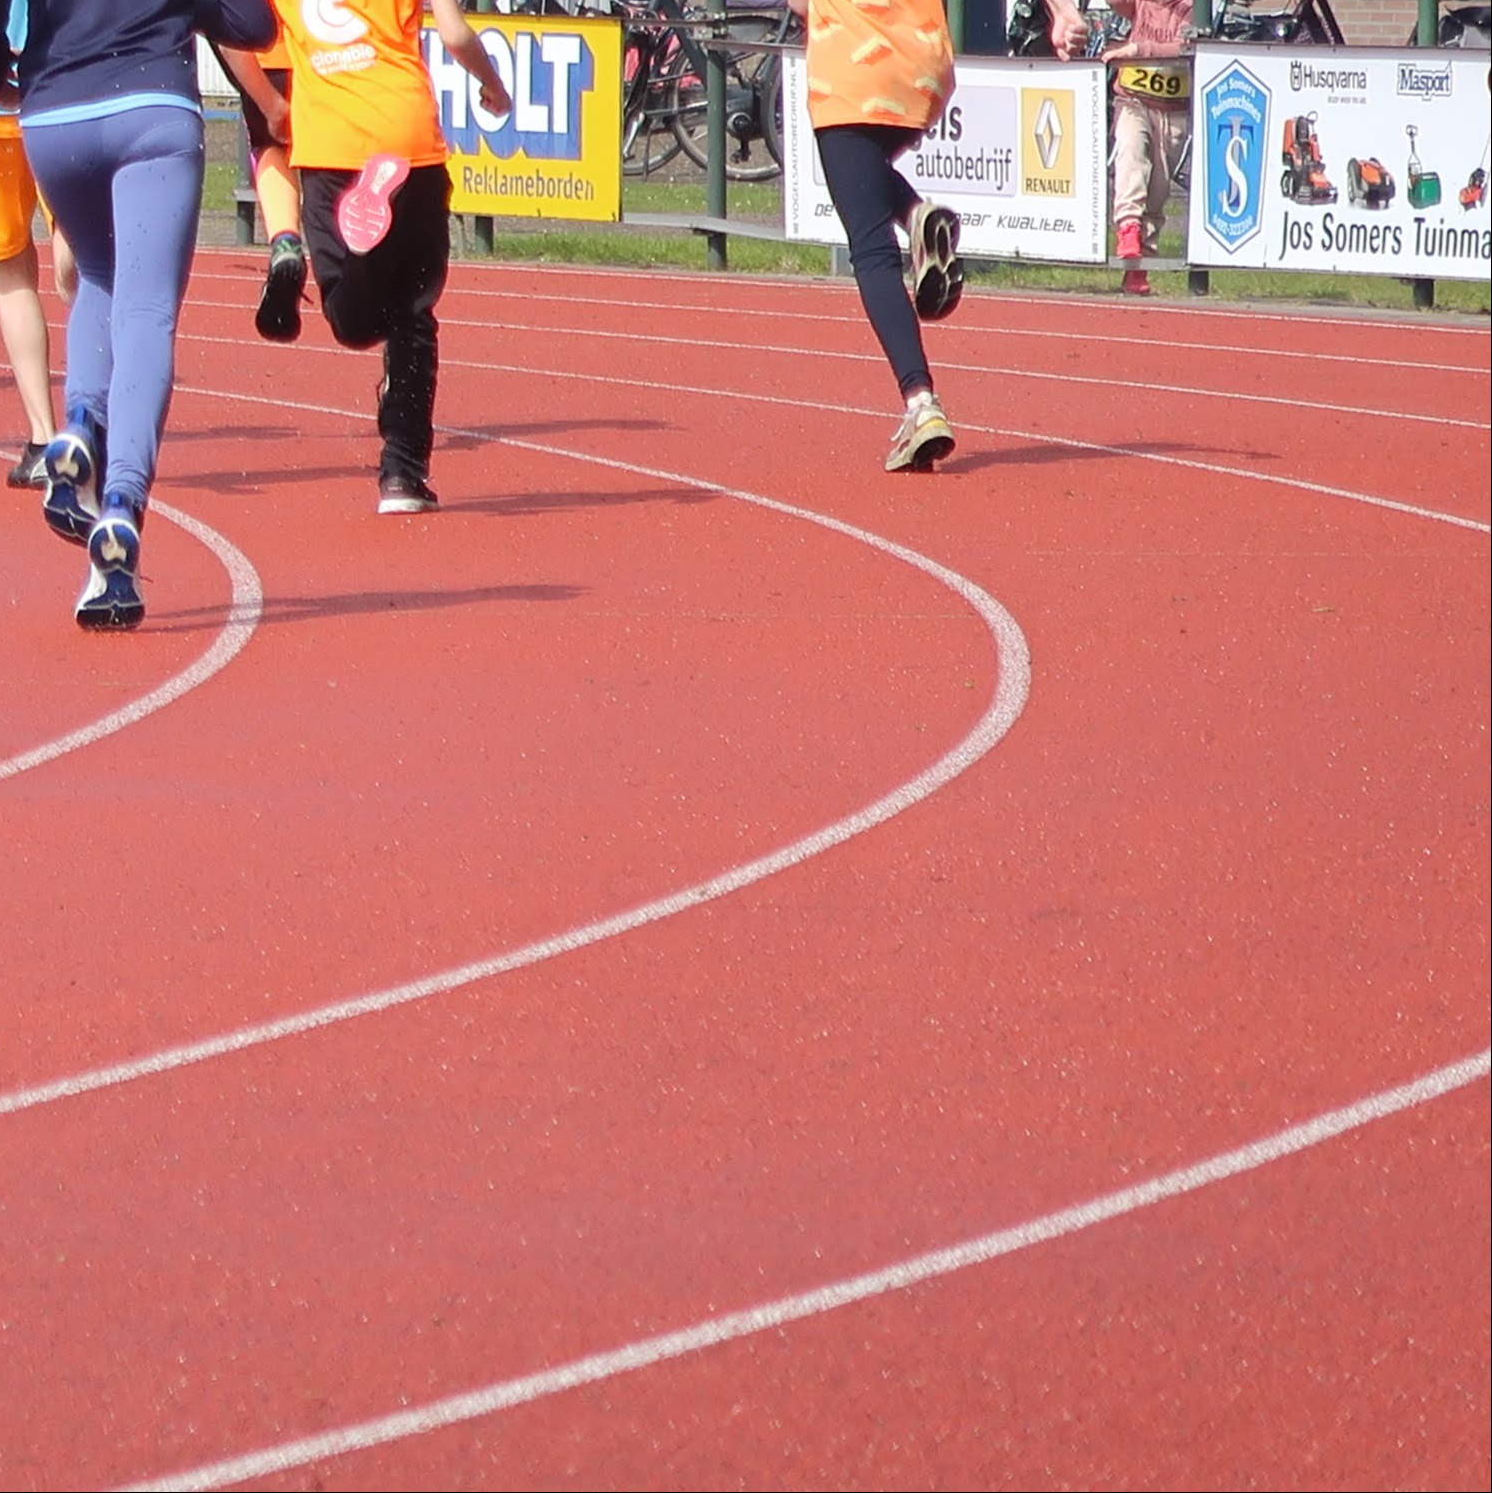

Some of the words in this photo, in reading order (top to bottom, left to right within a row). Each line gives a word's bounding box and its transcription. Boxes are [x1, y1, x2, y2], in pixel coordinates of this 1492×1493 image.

[420, 27, 581, 134] HOLT
[1132, 69, 1181, 96] 269
[1304, 65, 1367, 93] Husqvarna
[1400, 67, 1450, 93] Masport
[462, 165, 595, 201] Reklameborden
[915, 145, 1012, 192] autobedrijf
[1026, 177, 1071, 194] RENAULT
[1278, 211, 1314, 261] Jos
[1321, 212, 1403, 256] Somers
